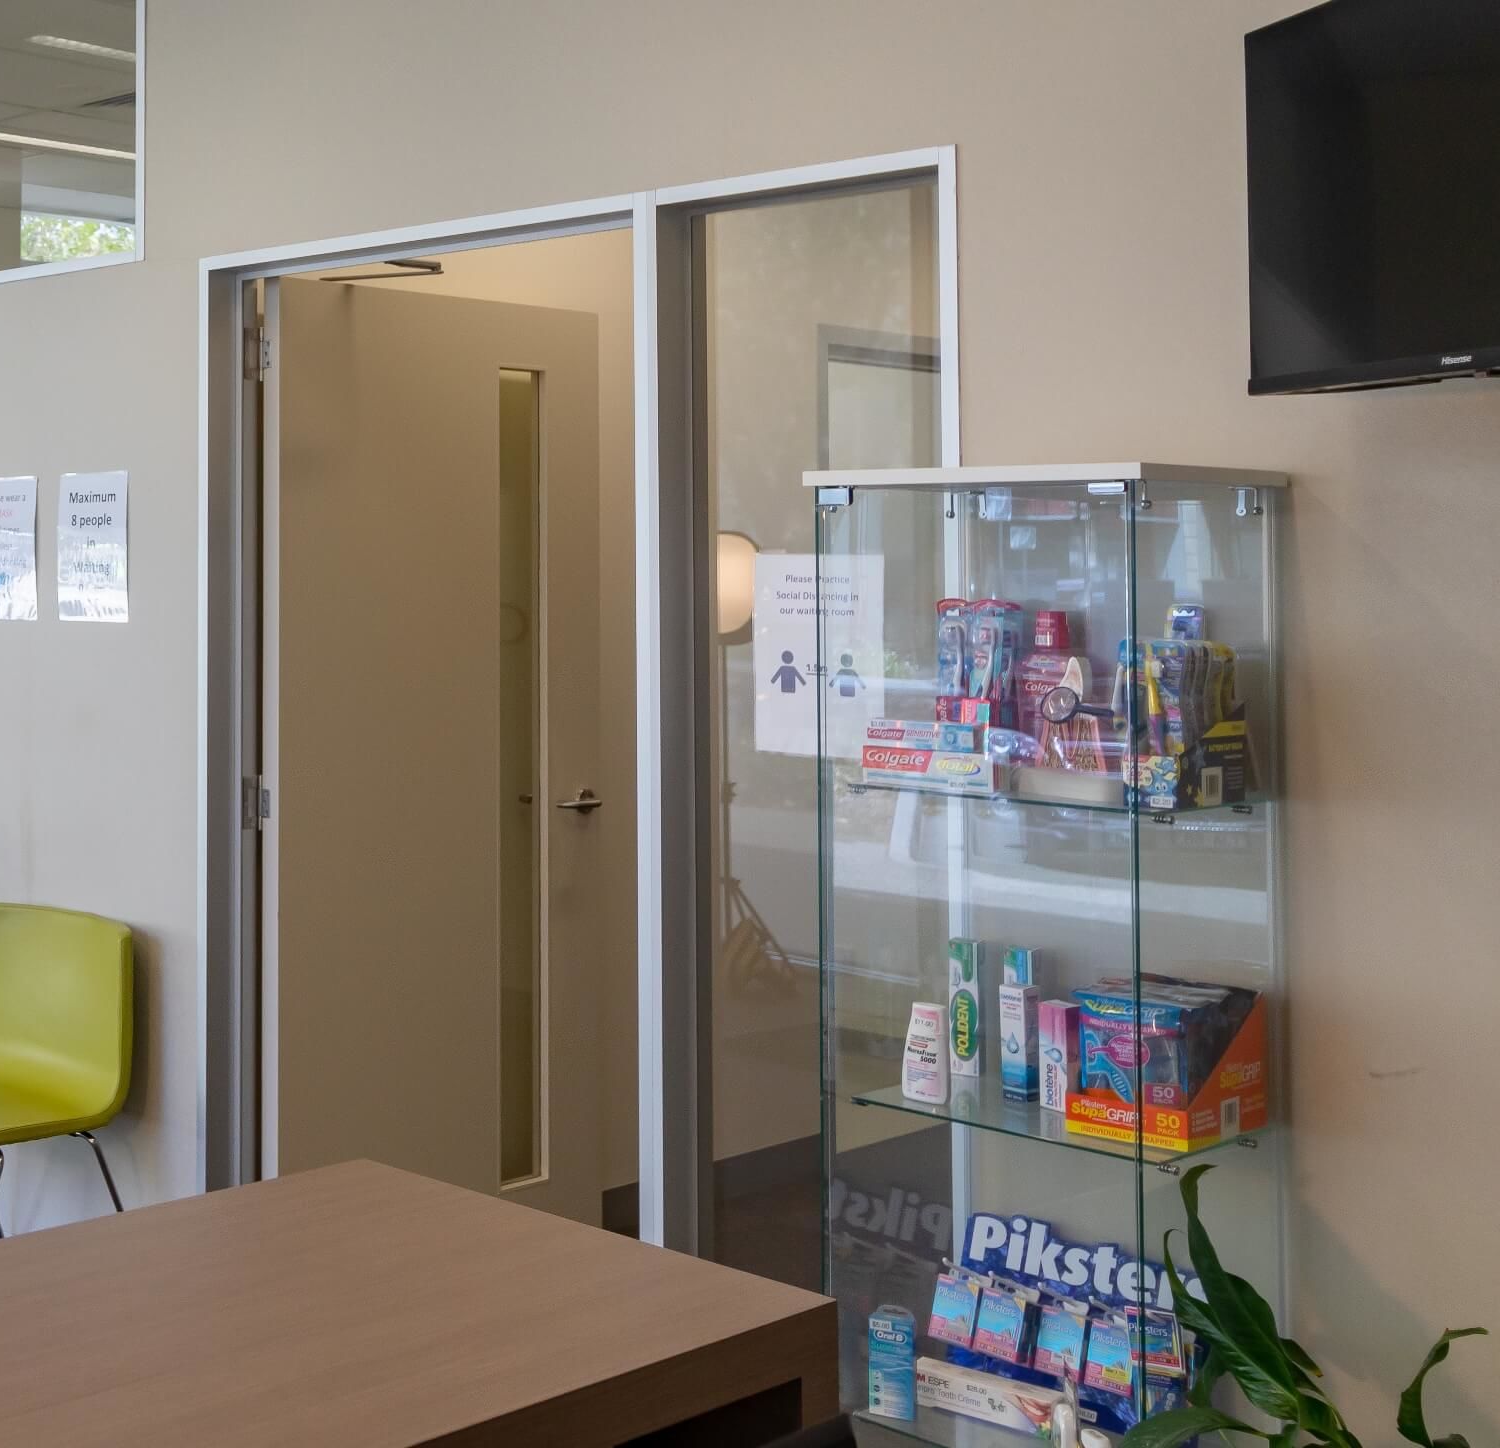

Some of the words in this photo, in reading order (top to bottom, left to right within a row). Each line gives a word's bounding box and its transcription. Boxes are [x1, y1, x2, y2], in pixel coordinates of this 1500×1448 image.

[69, 491, 116, 504] Maximum
[71, 514, 77, 527] 8
[79, 513, 112, 528] people
[785, 574, 812, 584] Please
[776, 590, 800, 601] Social
[803, 591, 848, 603] Disancing
[779, 607, 794, 616] our
[831, 609, 855, 617] room
[868, 728, 903, 738] Colgate
[866, 749, 925, 767] Colgate
[956, 995, 970, 1057] POLIDENT
[920, 1055, 937, 1065] 5000
[1152, 1086, 1175, 1098] 50
[1156, 1112, 1181, 1128] 50
[1156, 1127, 1180, 1137] PACK
[1128, 1322, 1169, 1338] Pisters
[928, 1376, 949, 1389] ESPE
[938, 1389, 957, 1401] Tooth
